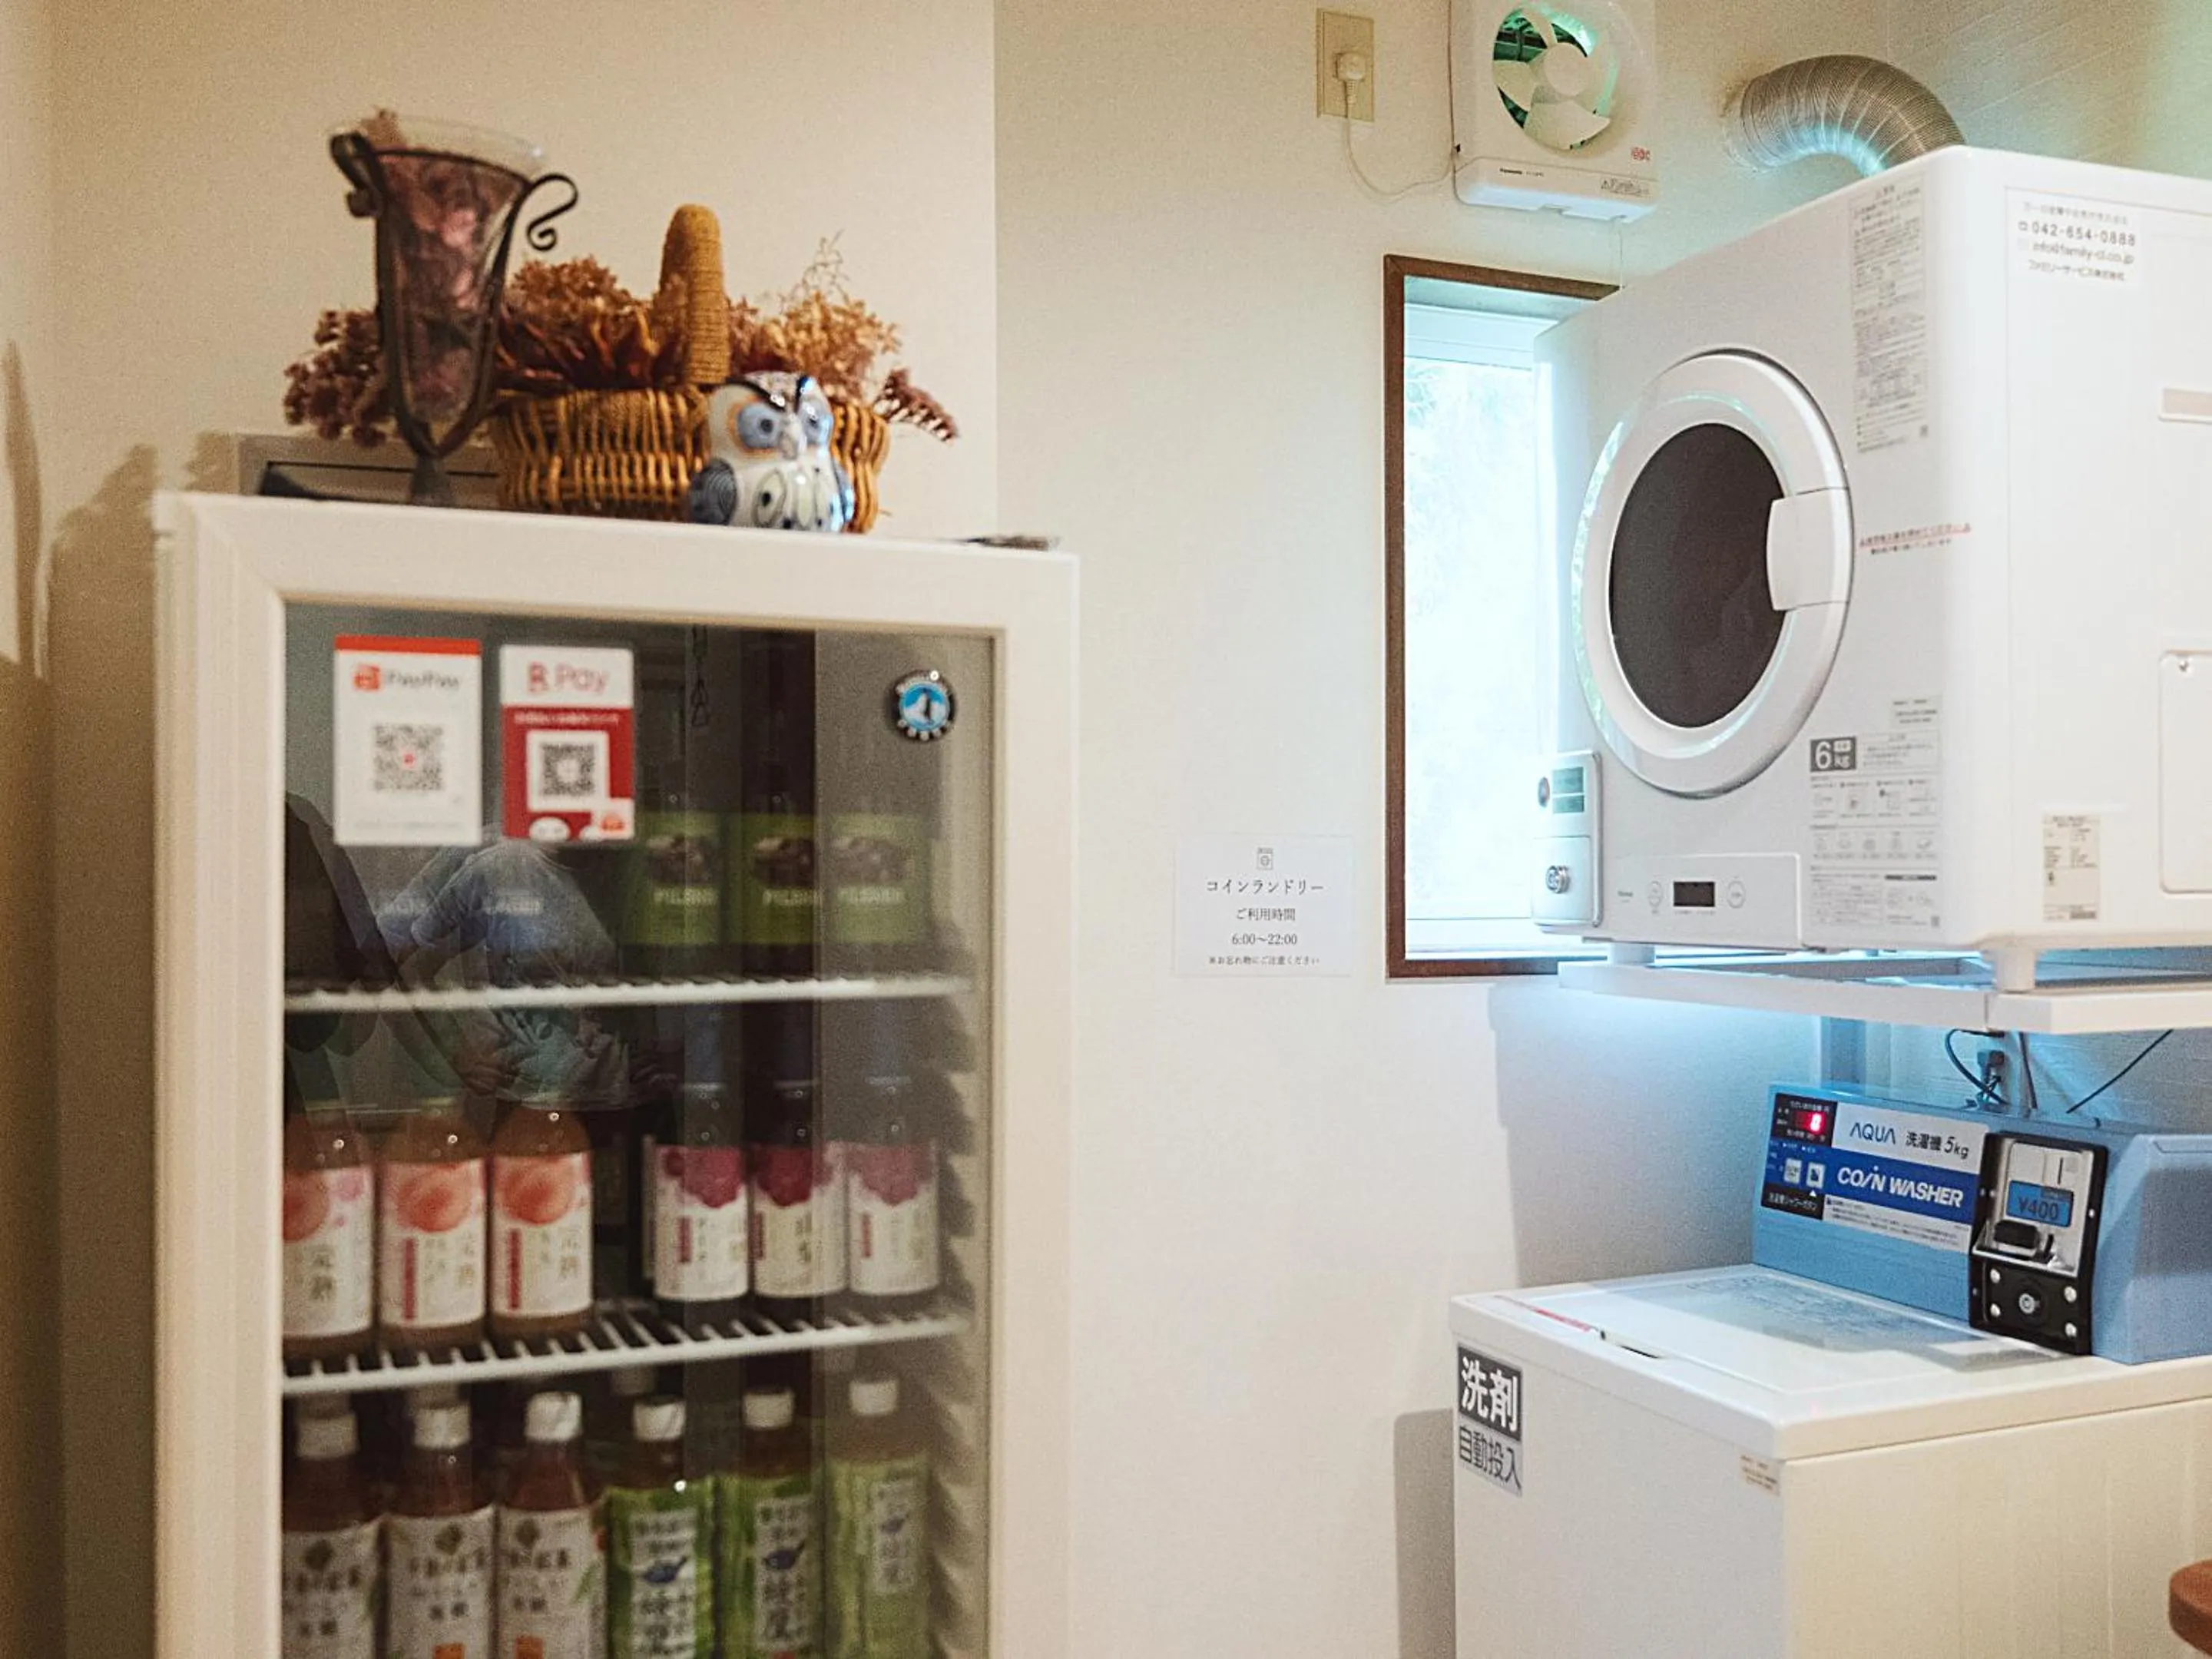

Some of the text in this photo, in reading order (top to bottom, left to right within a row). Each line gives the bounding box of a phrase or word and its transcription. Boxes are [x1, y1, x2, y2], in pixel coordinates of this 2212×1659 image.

[2032, 221, 2136, 247] 042-654-0888
[1815, 740, 1833, 770] 6
[1207, 879, 1324, 895] コインランドリー
[1236, 908, 1296, 922] ご利用時間
[1849, 1121, 1896, 1145] AQUA
[1943, 1136, 1970, 1160] 5kg
[1889, 1176, 1964, 1208] WASHER
[2018, 1196, 2060, 1220] ¥400
[1461, 1356, 1518, 1432] 洗剤
[1459, 1425, 1522, 1490] 自動投入
